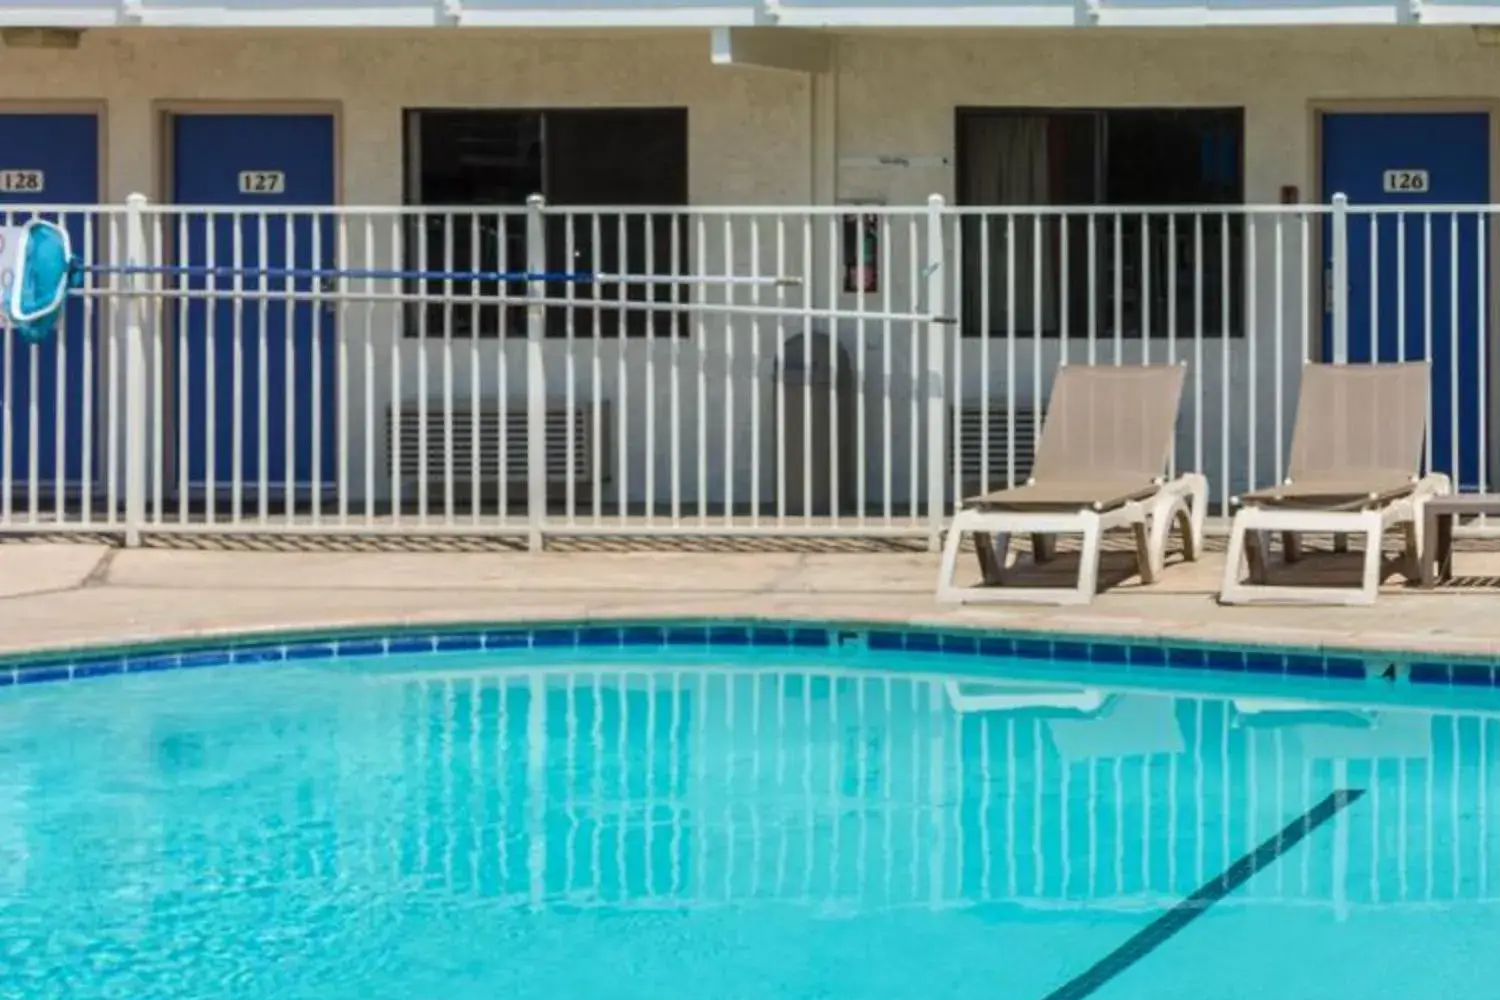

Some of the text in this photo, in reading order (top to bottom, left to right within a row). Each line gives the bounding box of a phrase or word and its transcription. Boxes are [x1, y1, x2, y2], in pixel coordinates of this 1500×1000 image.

[5, 172, 38, 190] 128
[243, 173, 280, 191] 127
[1390, 172, 1424, 190] 126
